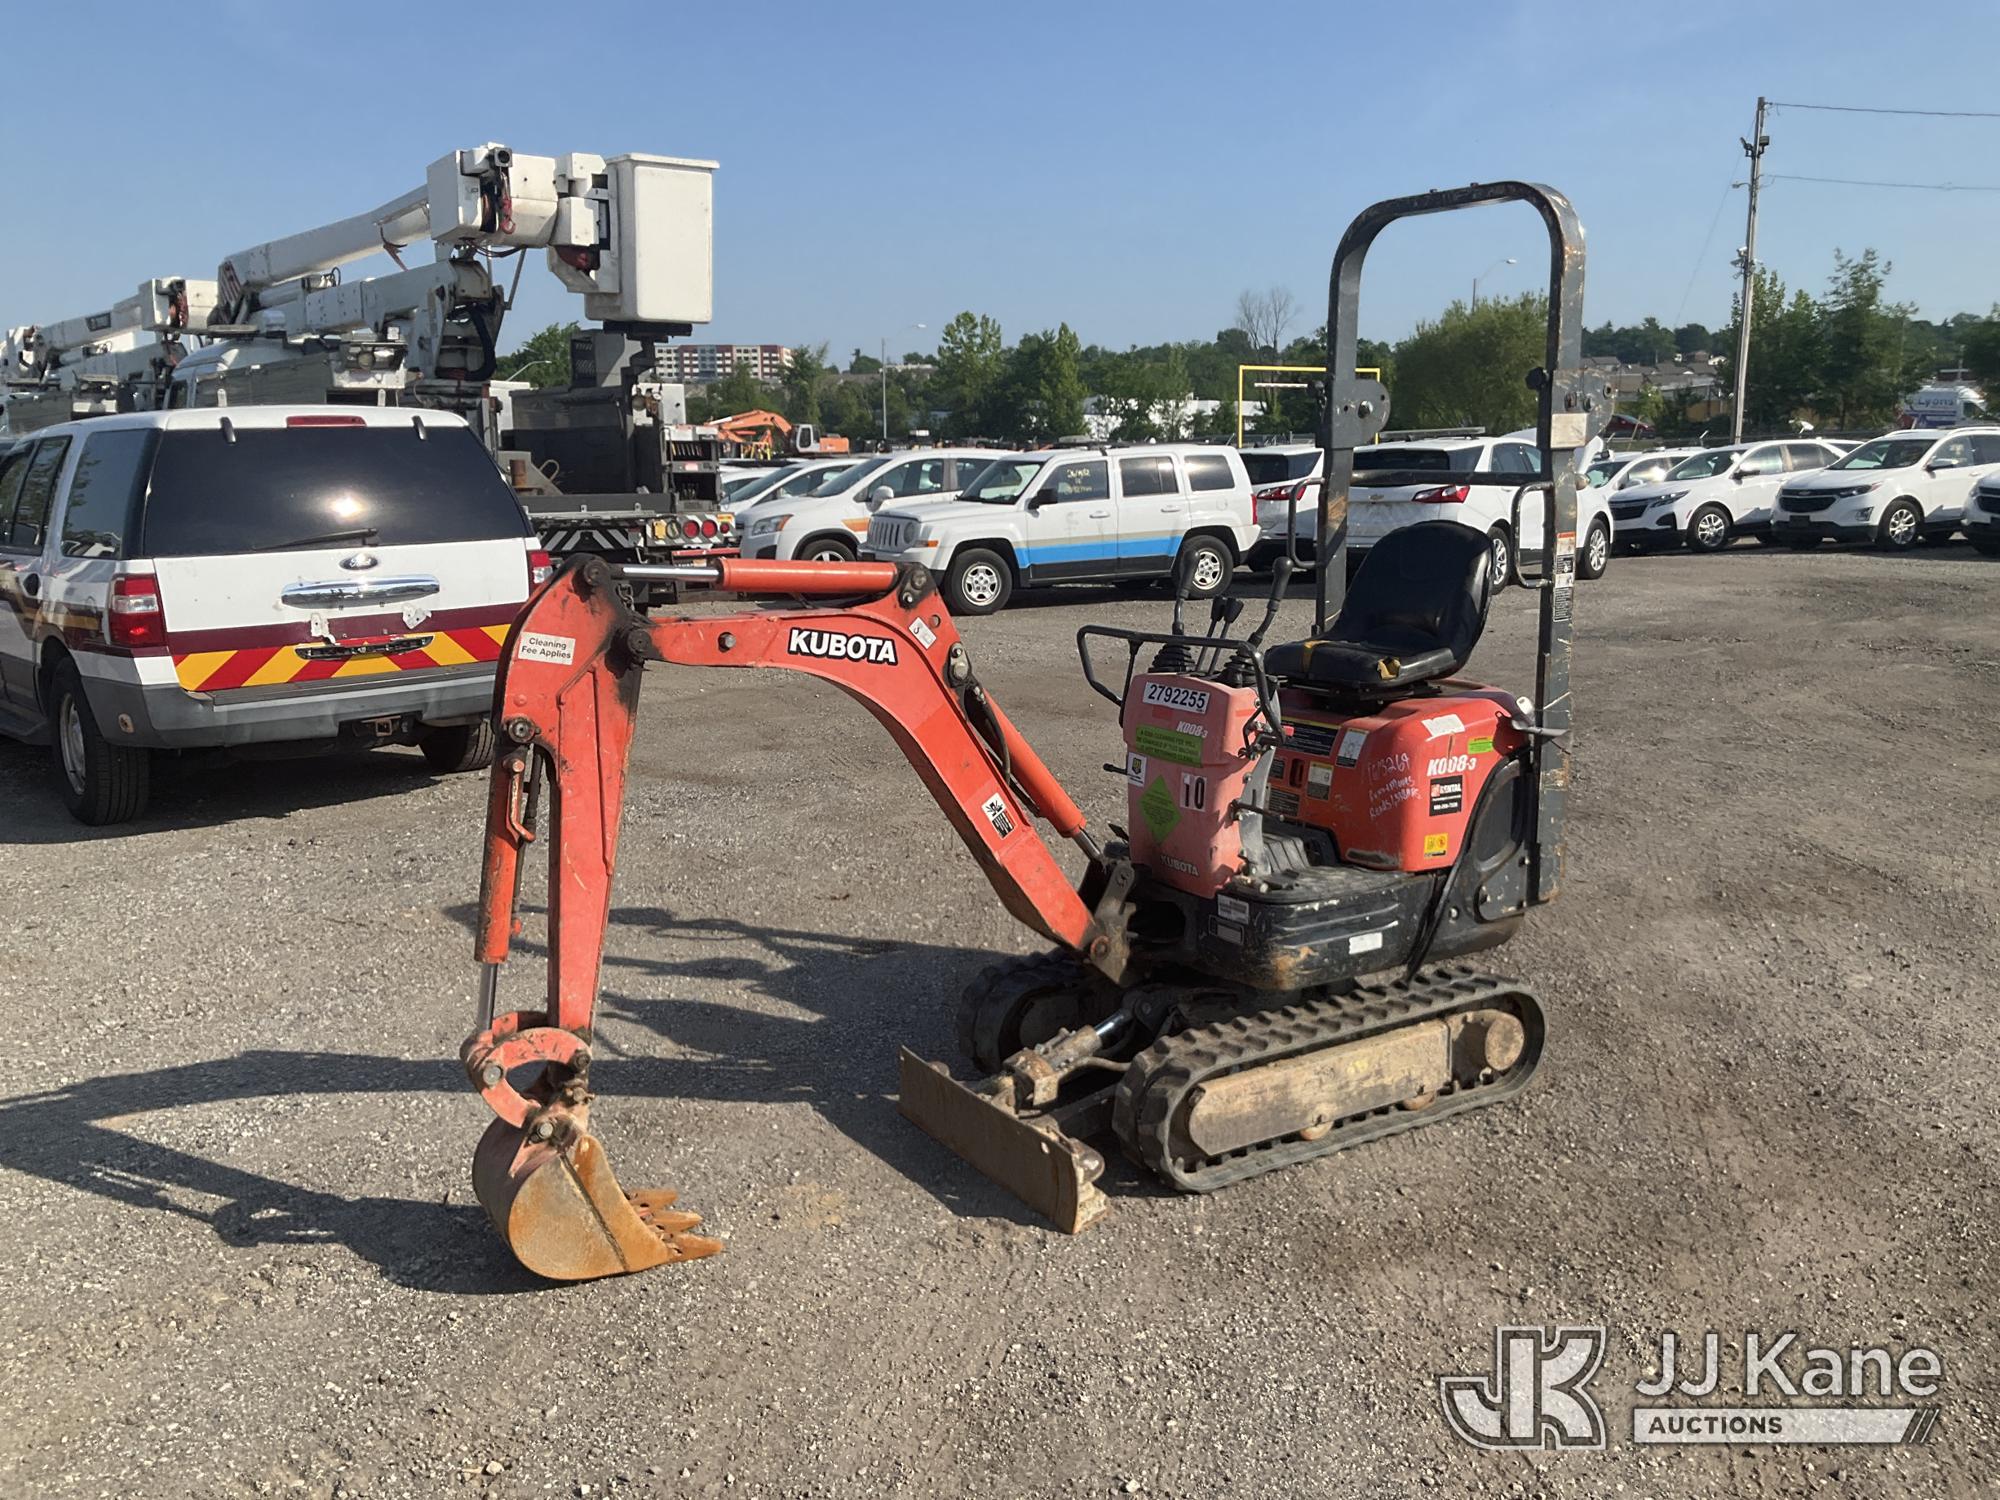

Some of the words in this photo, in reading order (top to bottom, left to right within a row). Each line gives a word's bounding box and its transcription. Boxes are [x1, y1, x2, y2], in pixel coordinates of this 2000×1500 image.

[1918, 398, 1954, 408] Lyons
[521, 645, 538, 655] Fee
[539, 648, 571, 659] Applies
[528, 637, 567, 650] Cleaning
[788, 627, 898, 665] KUBOTA
[1148, 684, 1207, 709] 2792255
[1176, 720, 1209, 738] K008-3
[1427, 755, 1477, 776] K008-3
[1183, 775, 1206, 810] 10
[1161, 855, 1199, 876] KUBOTA
